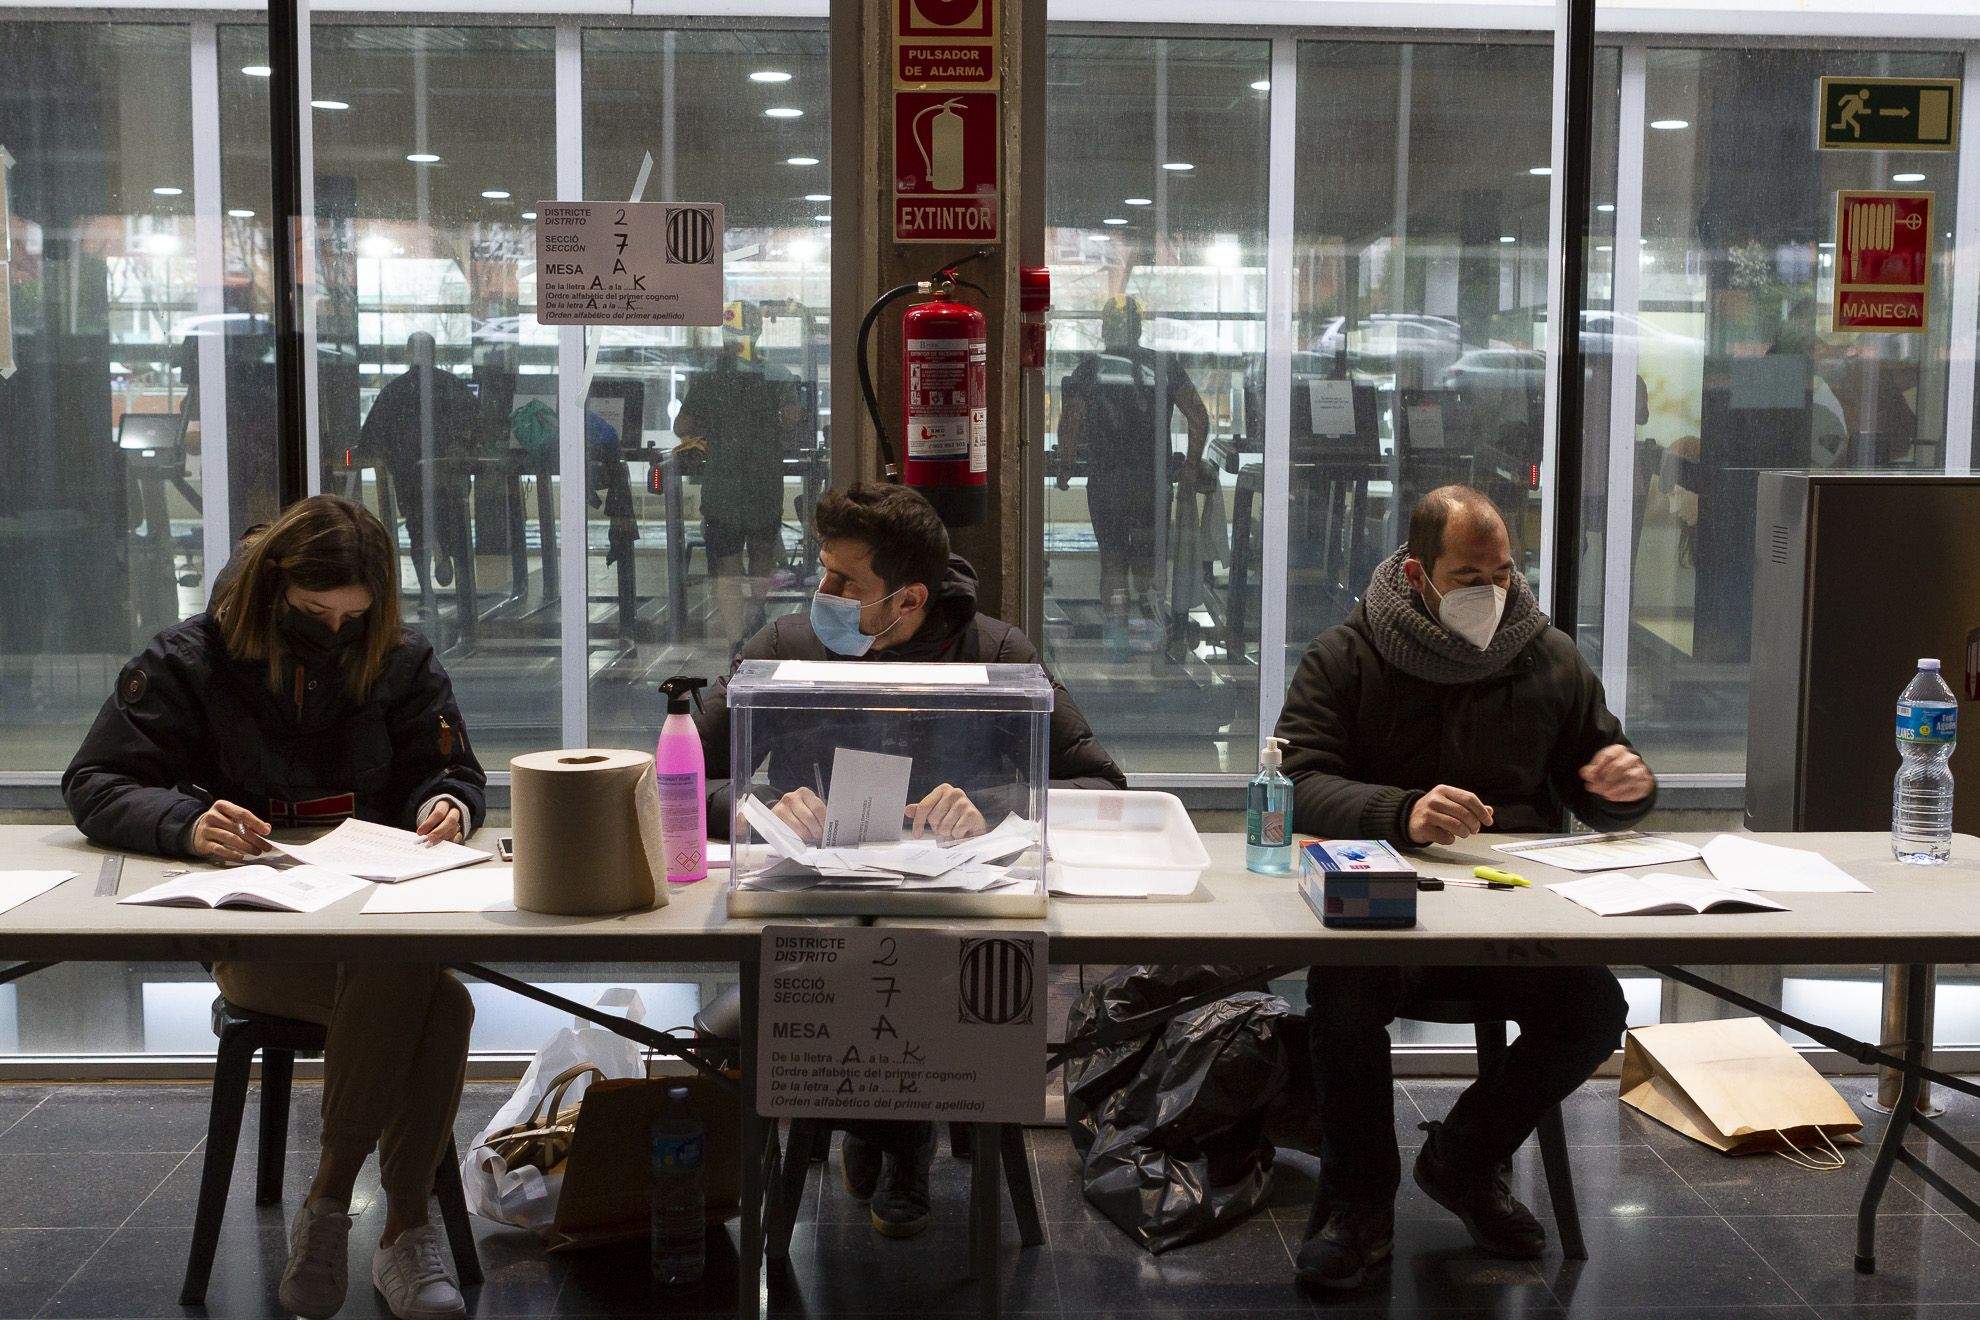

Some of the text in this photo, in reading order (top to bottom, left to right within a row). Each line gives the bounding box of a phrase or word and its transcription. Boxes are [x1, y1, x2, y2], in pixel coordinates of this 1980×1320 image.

[908, 49, 980, 60] PULSADOR
[904, 66, 985, 76] DE ALARMA
[544, 208, 592, 217] DISTRICTE
[613, 208, 628, 226] 2
[901, 206, 992, 231] EXTINTOR
[544, 217, 587, 226] DISTRITO
[544, 234, 579, 243] SECCIÓ
[613, 233, 629, 256] 7
[544, 243, 586, 252] SECCIÓN
[545, 264, 584, 275] MESA
[612, 258, 627, 275] A
[590, 275, 603, 290] A
[633, 275, 646, 291] K
[586, 298, 598, 310] A
[626, 299, 636, 311] K
[645, 294, 679, 302] cognom)
[1843, 299, 1919, 319] MÀNEGA
[546, 312, 572, 320] (Orden
[612, 312, 624, 320] del
[652, 313, 685, 321] apellido)
[775, 936, 846, 950] DISTRICTE
[774, 950, 838, 963] DISTRITO
[872, 937, 898, 966] 2
[773, 977, 825, 991] SECCIÓ
[773, 991, 835, 1004] SECCIÓN
[871, 976, 901, 1008] 7
[772, 1022, 830, 1039] MESA
[871, 1014, 898, 1040] A
[772, 1041, 926, 1066] De la lletra A a la K
[771, 1066, 808, 1078] (Ordre
[864, 1068, 881, 1078] del
[884, 1070, 922, 1080] primer
[926, 1070, 977, 1082] cognom)
[771, 1080, 787, 1091] De
[790, 1080, 800, 1092] la
[804, 1081, 829, 1092] letra
[858, 1084, 866, 1092] a
[869, 1082, 879, 1092] la
[770, 1096, 810, 1106] (Orden
[874, 1098, 892, 1108] del
[894, 1100, 931, 1110] primer
[935, 1100, 985, 1112] apellido)
